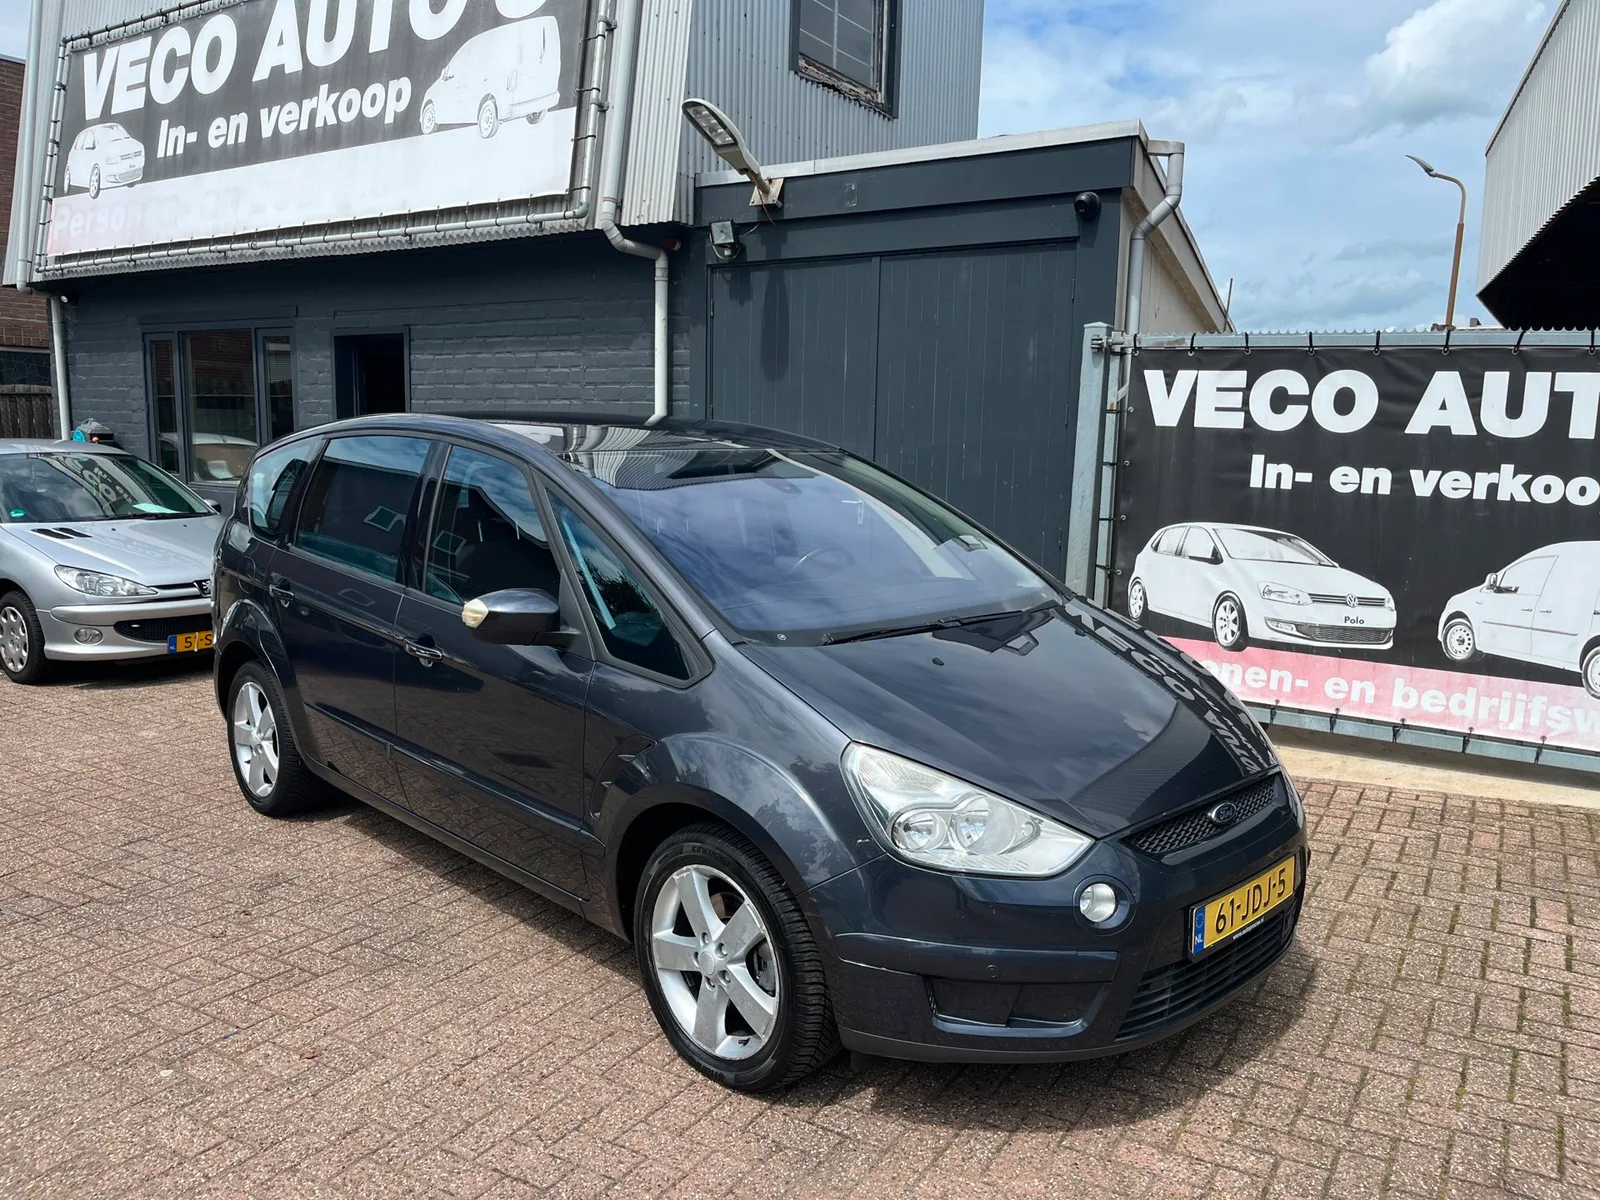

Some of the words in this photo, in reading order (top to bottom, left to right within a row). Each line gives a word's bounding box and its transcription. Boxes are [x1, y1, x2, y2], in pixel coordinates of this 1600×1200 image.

[83, 13, 237, 121] VECO
[157, 119, 198, 158] In-
[208, 111, 248, 149] en
[260, 76, 411, 138] verkoop
[1143, 369, 1379, 434] VECO
[1249, 454, 1313, 490] In-
[1329, 464, 1392, 496] en
[1410, 464, 1600, 506] verkoo
[1344, 616, 1365, 625] Polo
[1324, 676, 1376, 704] en
[1215, 867, 1286, 934] 61-JDJ-5
[1194, 933, 1203, 945] NL
